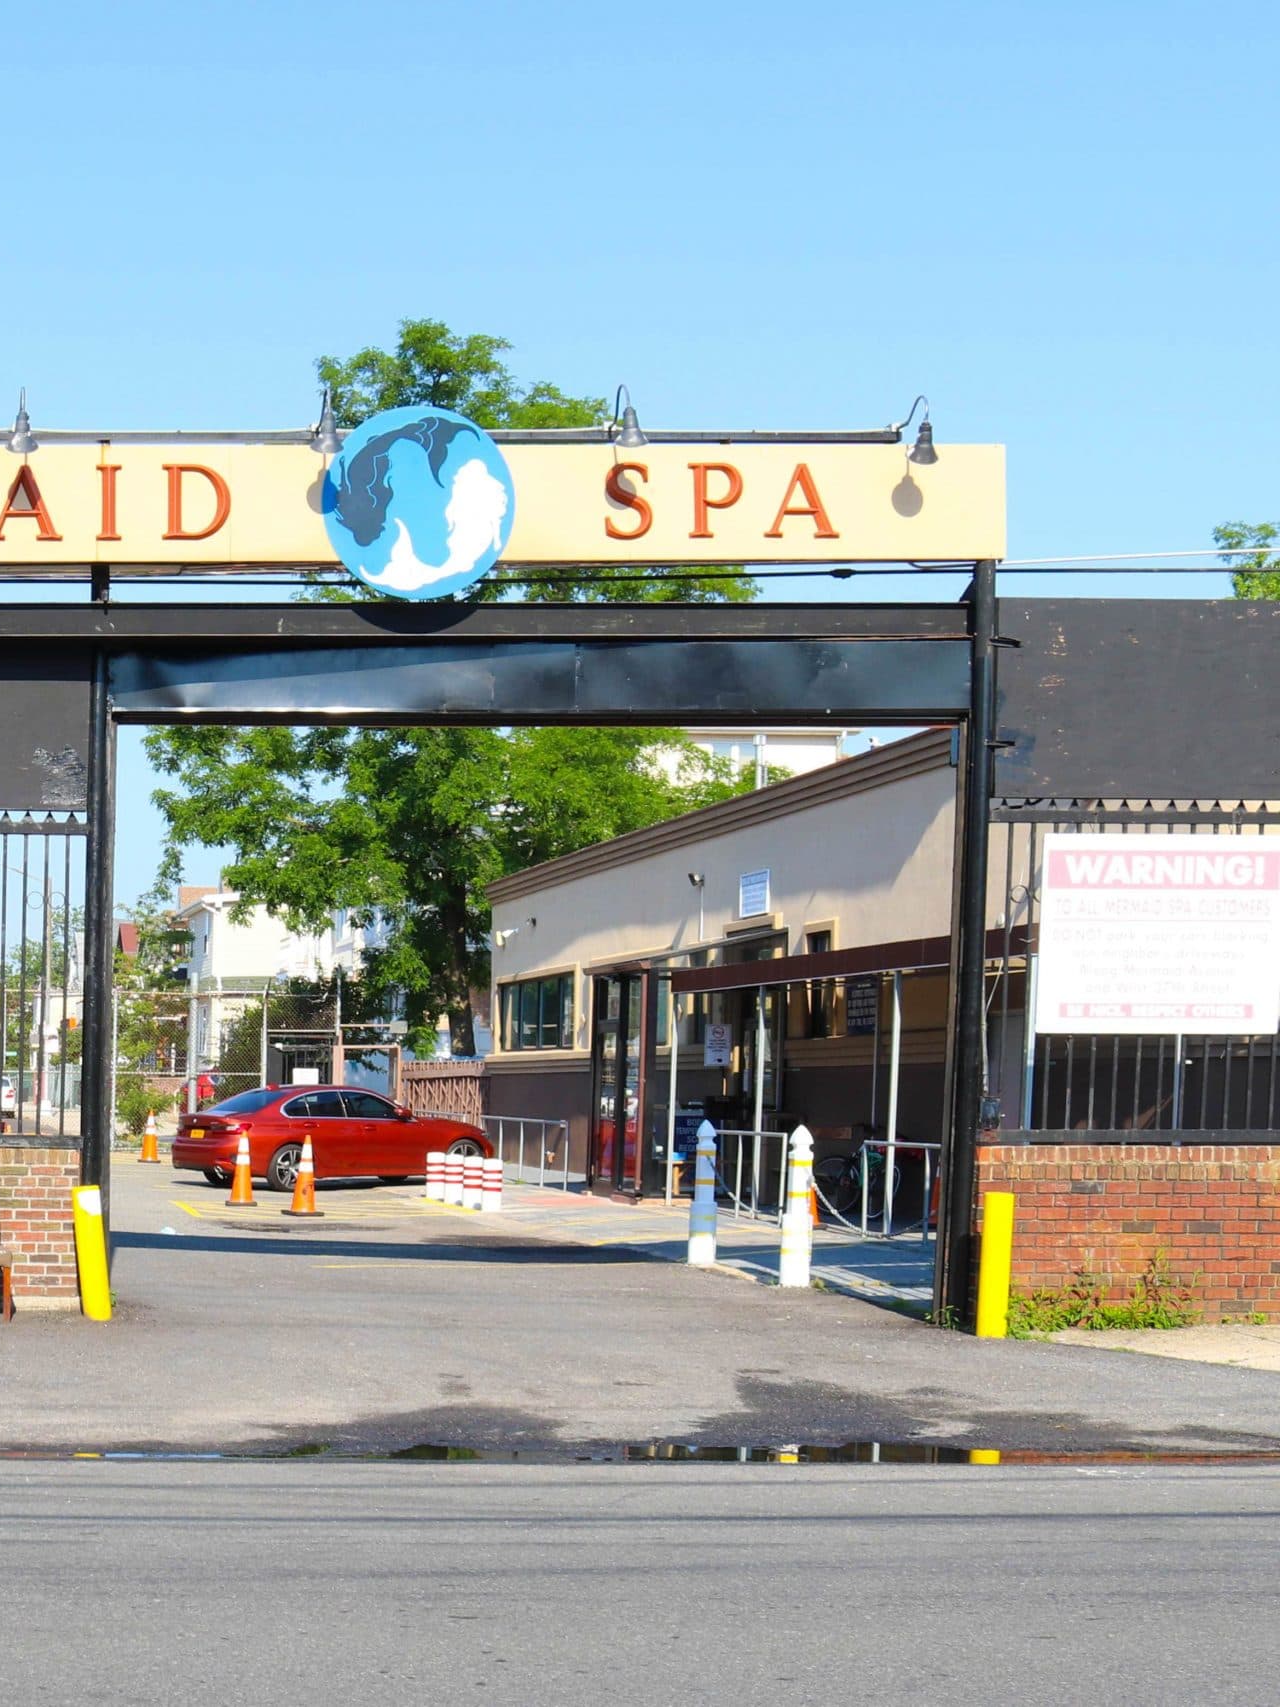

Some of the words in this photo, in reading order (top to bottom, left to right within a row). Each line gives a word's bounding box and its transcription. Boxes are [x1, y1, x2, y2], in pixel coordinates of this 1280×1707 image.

[603, 461, 840, 541] SPA
[1065, 856, 1265, 885] WARNING!
[1167, 898, 1192, 915] SPA
